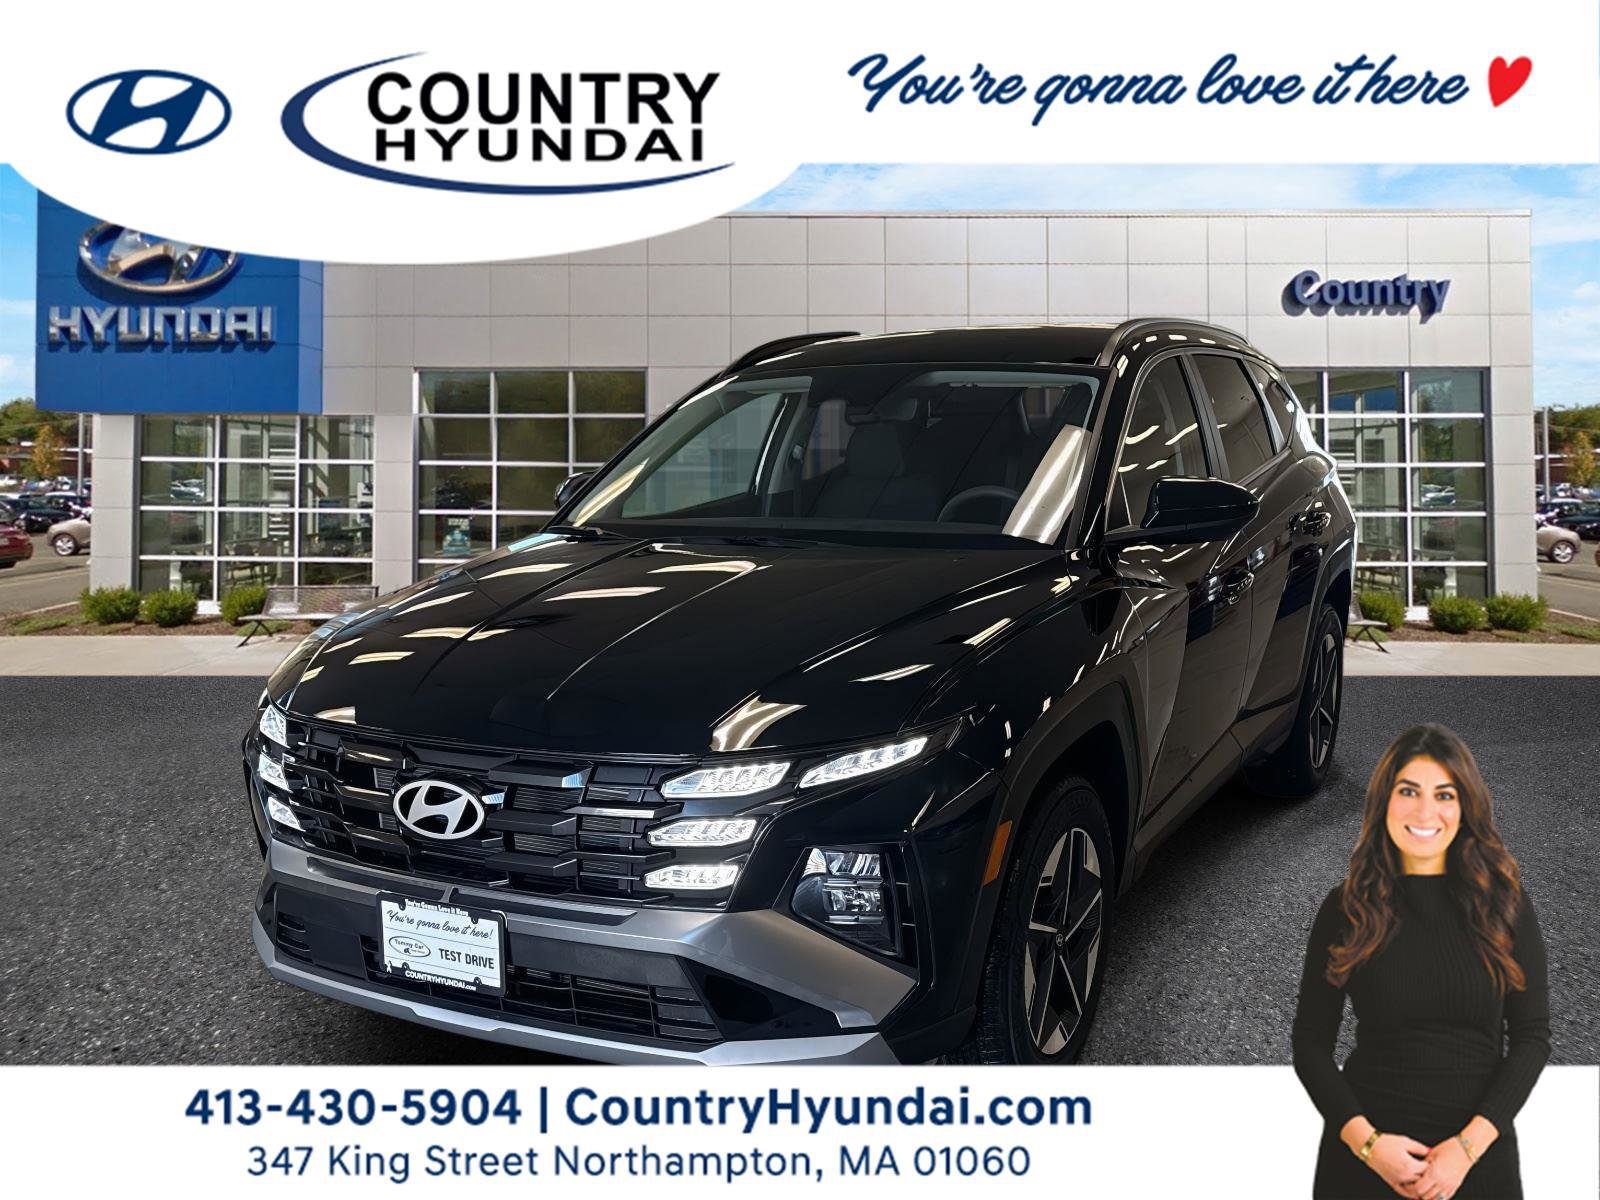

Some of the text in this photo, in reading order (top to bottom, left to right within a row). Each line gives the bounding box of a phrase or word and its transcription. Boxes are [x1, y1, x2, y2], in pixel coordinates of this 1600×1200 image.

[1283, 269, 1452, 322] Country
[48, 306, 273, 345] HYUNDAI
[387, 909, 494, 940] You're gonna love it here!
[438, 948, 495, 969] TEST DRIVE
